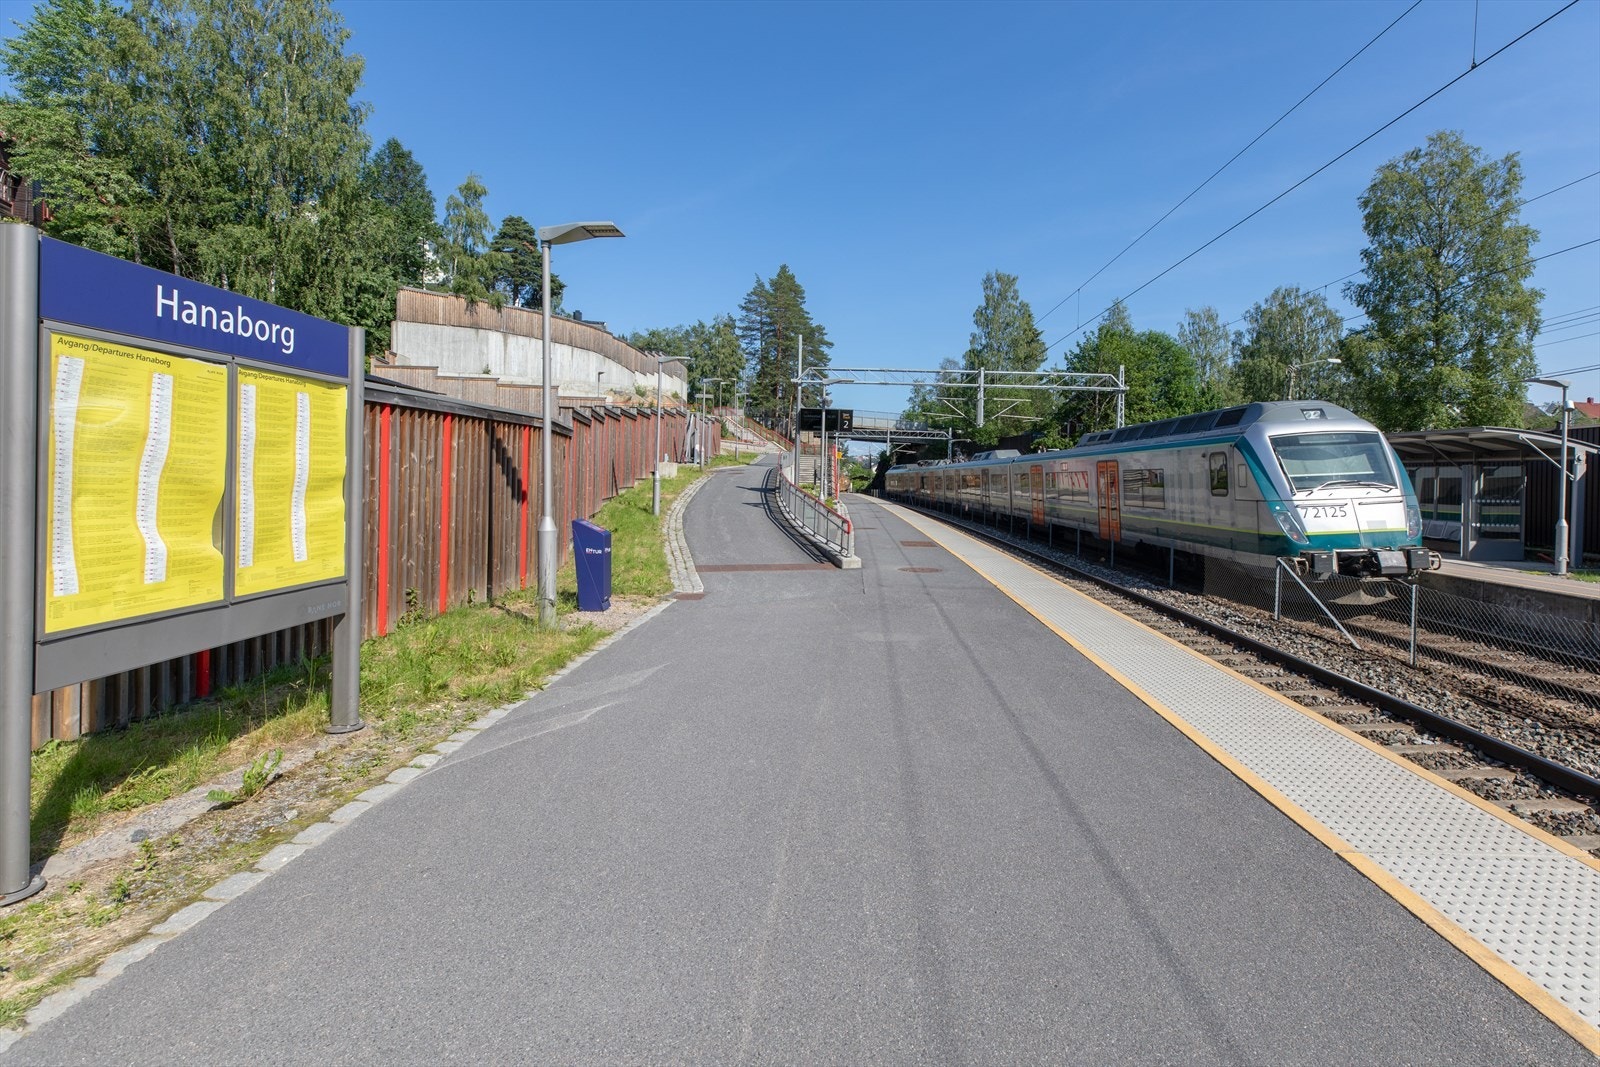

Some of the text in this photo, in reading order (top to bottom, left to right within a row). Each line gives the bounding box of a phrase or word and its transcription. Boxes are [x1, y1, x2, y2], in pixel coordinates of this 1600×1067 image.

[156, 285, 295, 354] Hanaborg
[57, 336, 171, 368] Avgang/Departures Hanaborg
[1301, 506, 1346, 518] 72125
